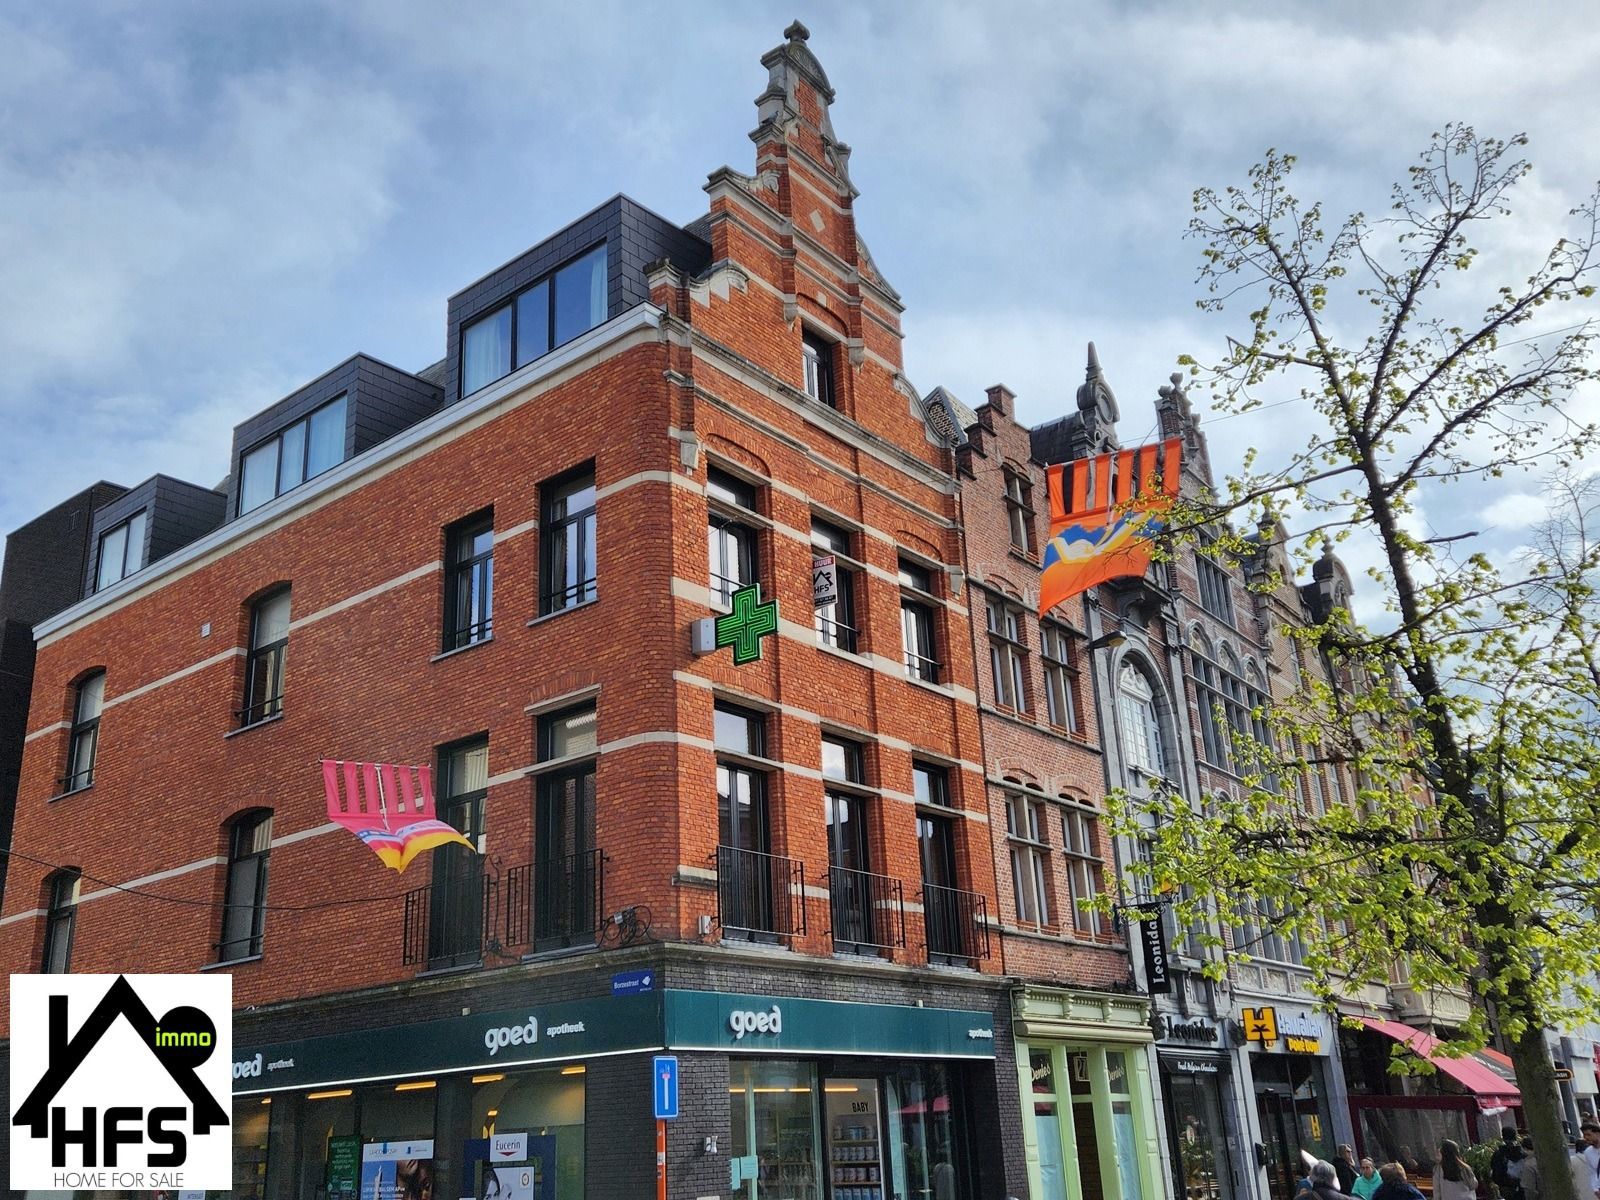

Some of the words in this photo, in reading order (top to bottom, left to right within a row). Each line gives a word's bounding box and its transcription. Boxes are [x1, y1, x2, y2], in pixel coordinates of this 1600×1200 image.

[814, 584, 830, 594] HFS
[1146, 920, 1166, 984] Leonida
[729, 1004, 782, 1040] goed
[1166, 1015, 1219, 1043] Leonidas
[1277, 1012, 1325, 1038] Hawaiian
[484, 1015, 538, 1057] goed
[546, 1021, 586, 1038] apotheek
[232, 1053, 262, 1078] oed
[852, 1101, 869, 1113] BABY
[495, 1139, 521, 1151] Eucerin
